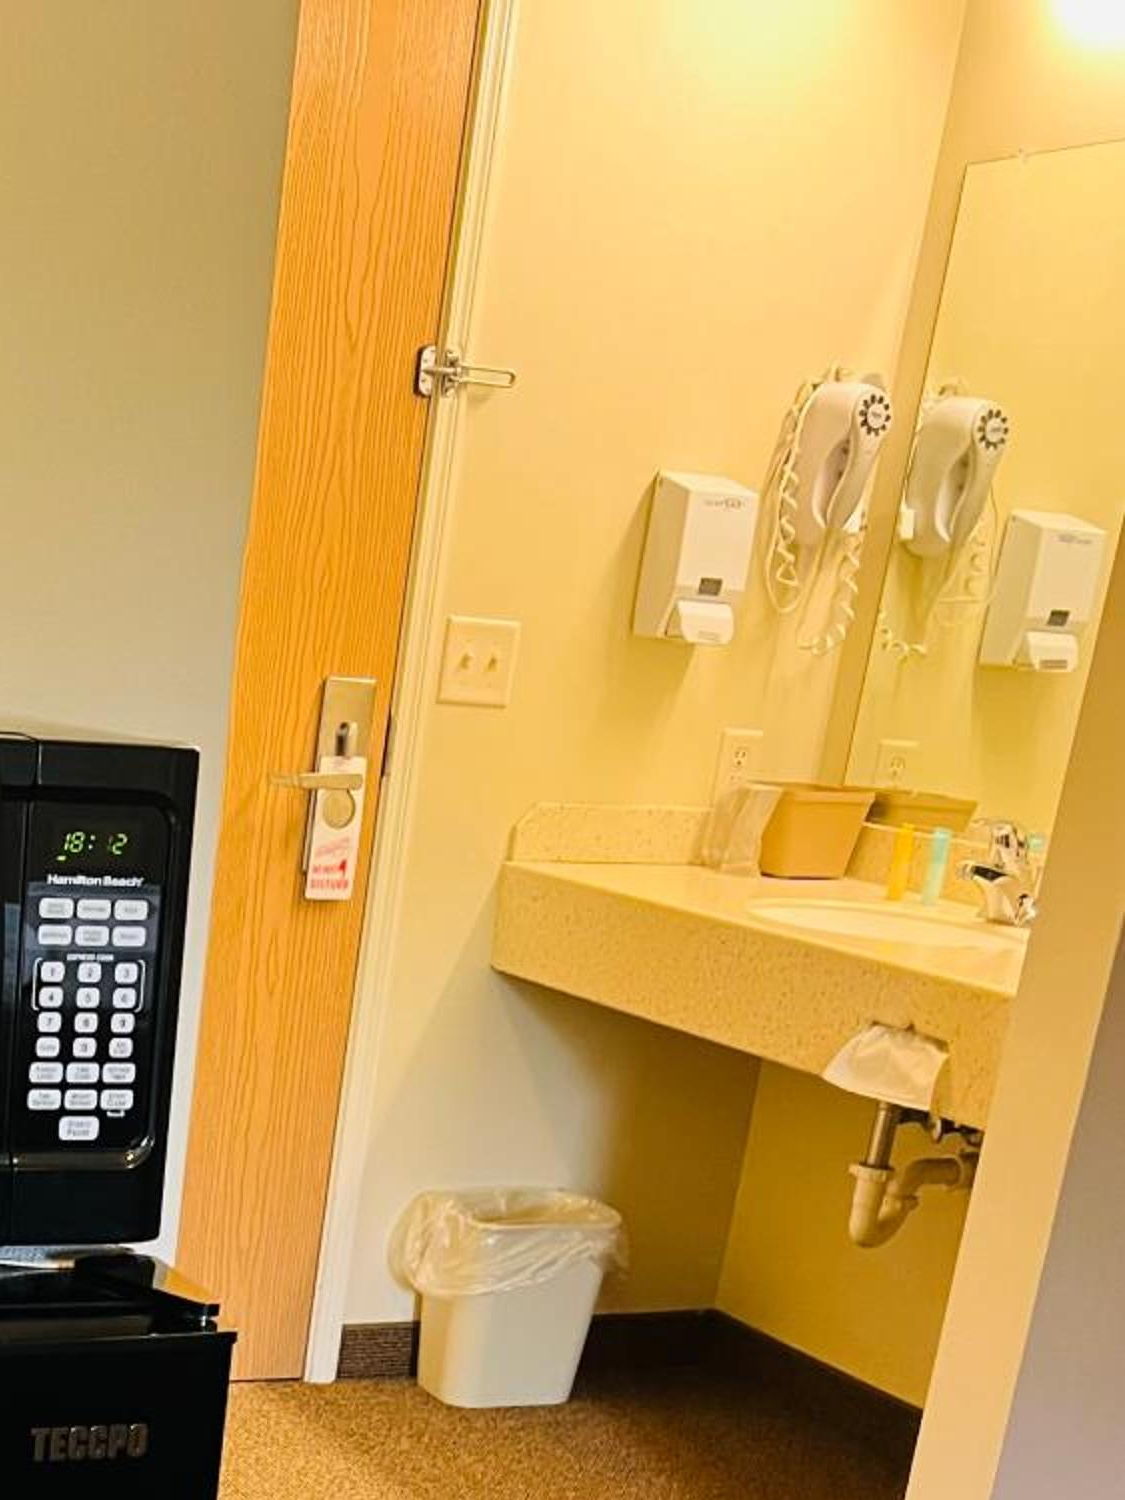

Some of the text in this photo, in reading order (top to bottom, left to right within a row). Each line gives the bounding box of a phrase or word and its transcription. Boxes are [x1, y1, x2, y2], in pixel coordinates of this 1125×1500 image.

[46, 874, 142, 888] Hamilton Beach
[31, 1423, 148, 1461] TECCPO
